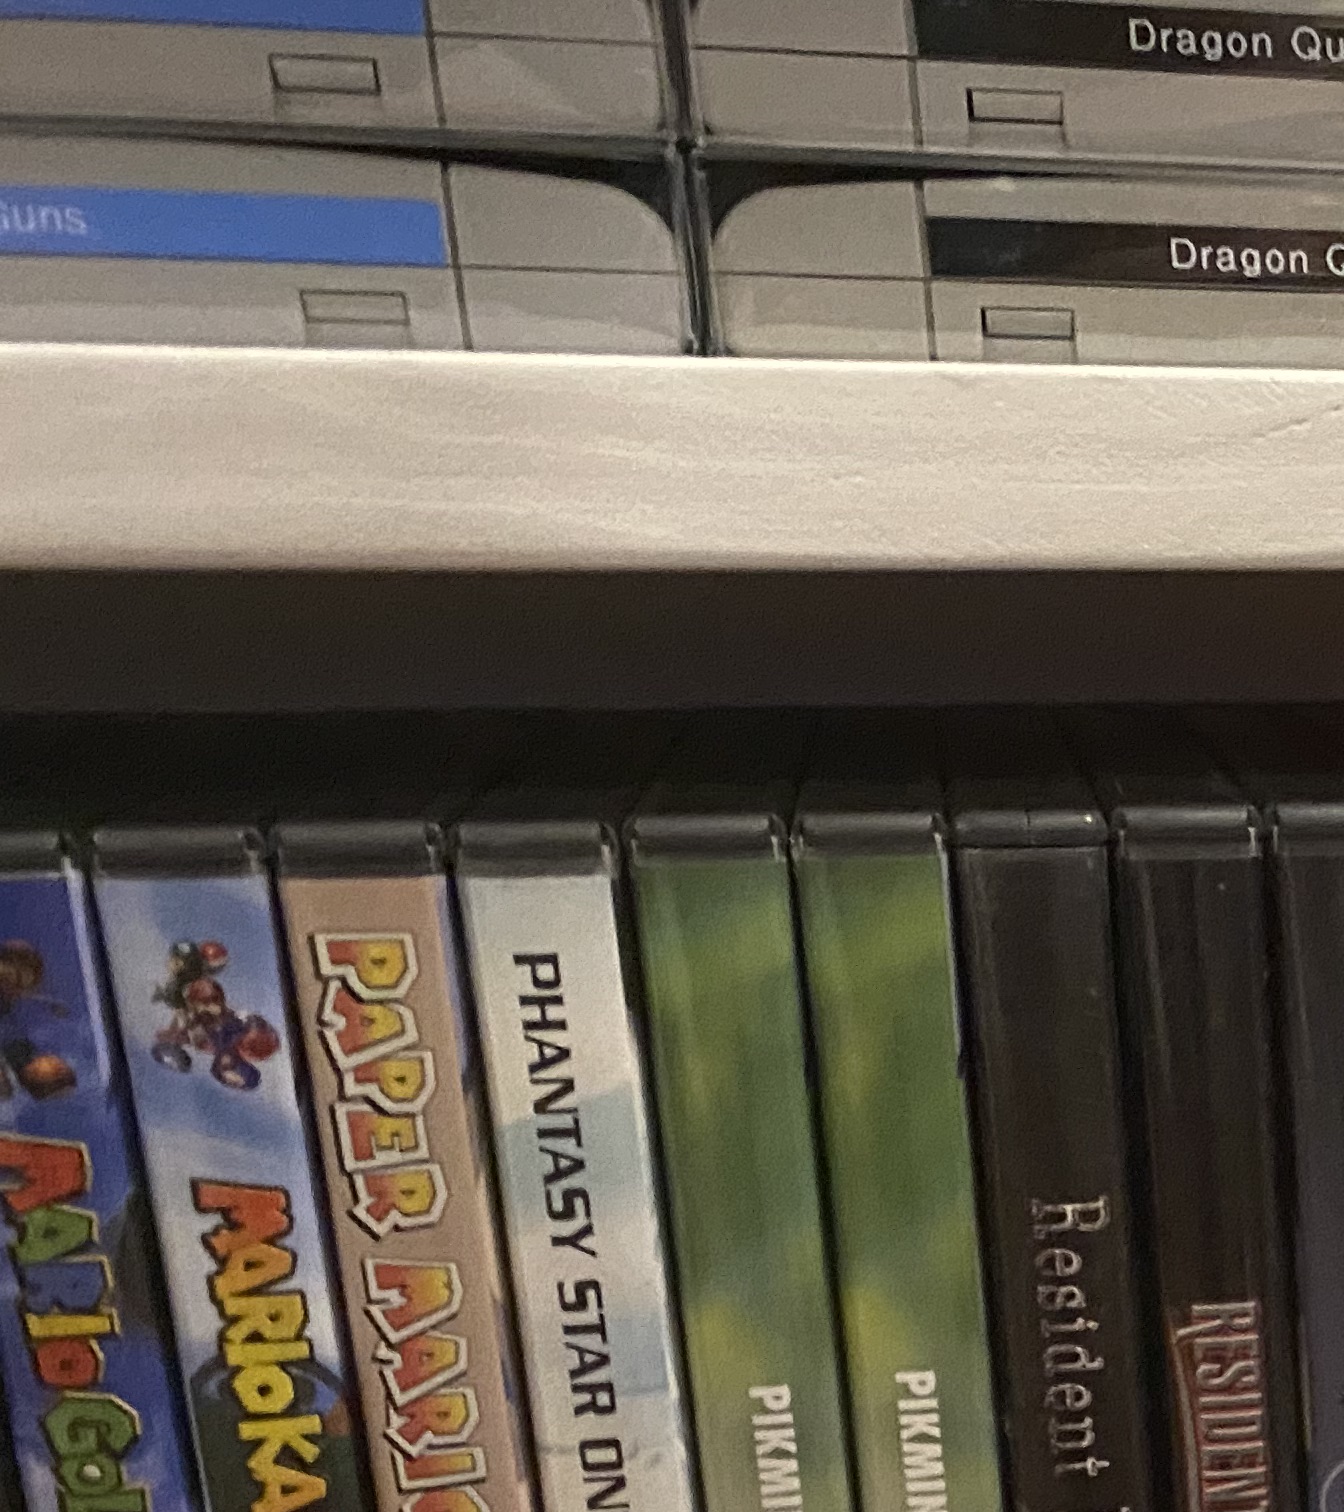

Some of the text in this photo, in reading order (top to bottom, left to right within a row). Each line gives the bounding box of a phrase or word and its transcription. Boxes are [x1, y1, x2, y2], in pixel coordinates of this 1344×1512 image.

[1128, 18, 1274, 64] Dragon
[1169, 236, 1310, 279] Dragon
[310, 932, 449, 1241] PAPER
[512, 951, 598, 1260] PHANTASY
[556, 1278, 618, 1417] STAR
[1030, 1195, 1112, 1481] Resident
